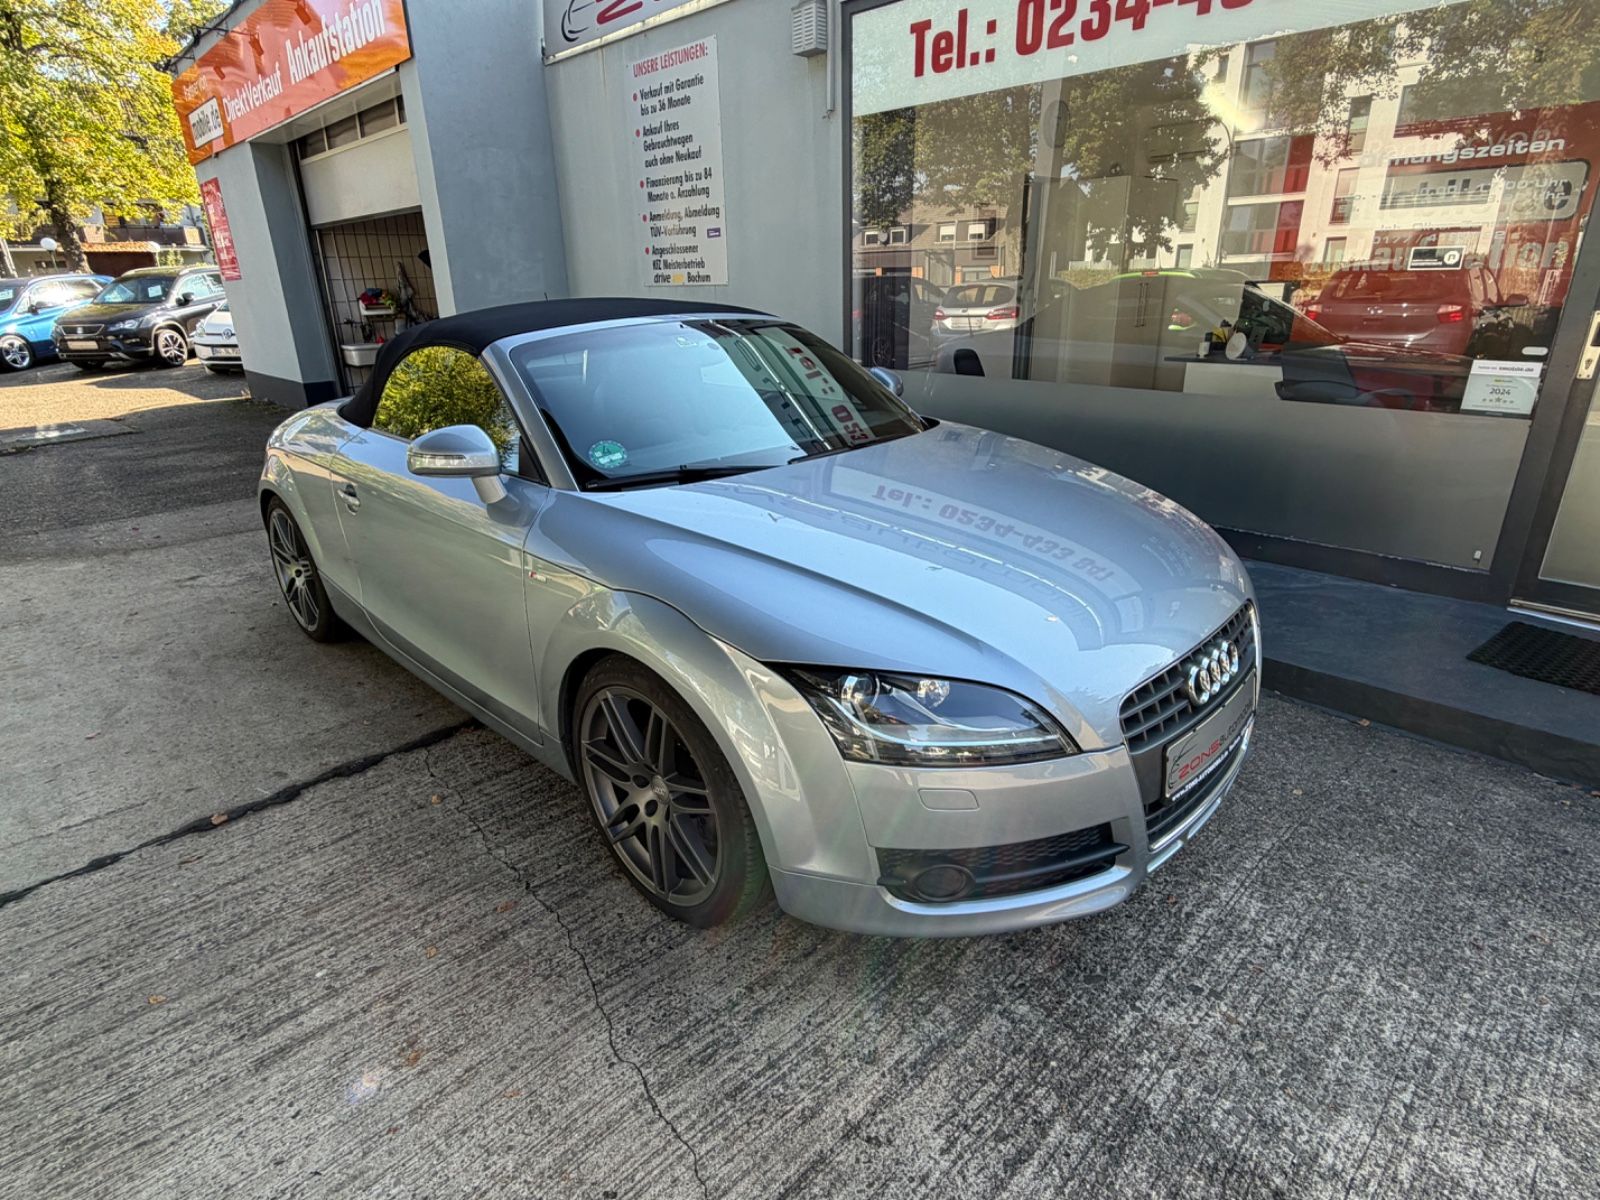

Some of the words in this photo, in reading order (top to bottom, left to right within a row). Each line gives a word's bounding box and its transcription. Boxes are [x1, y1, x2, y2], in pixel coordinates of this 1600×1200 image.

[285, 0, 385, 84] Ankaufstation
[910, 9, 997, 78] Tel.:
[1016, 0, 1253, 56] 0234-
[633, 57, 659, 77] UNSERE
[223, 62, 283, 122] DirektVerkauf
[639, 82, 663, 101] Verkauf
[664, 81, 674, 95] mit
[675, 73, 704, 91] Garantie
[640, 104, 649, 117] bis
[650, 105, 657, 114] zu
[658, 99, 666, 111] 36
[667, 95, 691, 110] Monate
[643, 120, 663, 137] Ankauf
[664, 120, 680, 132] Ihres
[643, 134, 694, 152] Gebrauchtwagen
[644, 155, 658, 168] auch
[659, 153, 674, 165] ohne
[675, 145, 702, 162] Neukauf
[646, 175, 683, 189] Finanzierung
[684, 170, 694, 183] bis
[695, 172, 702, 180] zu
[703, 167, 712, 179] 84
[647, 190, 669, 202] Monate
[677, 184, 710, 199] Anzahlung
[684, 204, 720, 218] Abmeldung
[652, 243, 699, 258] Angeschlossener
[663, 257, 705, 270] Meisterbetrieb
[654, 272, 671, 283] drive
[687, 271, 711, 283] Bochum
[1489, 387, 1511, 396] 2024
